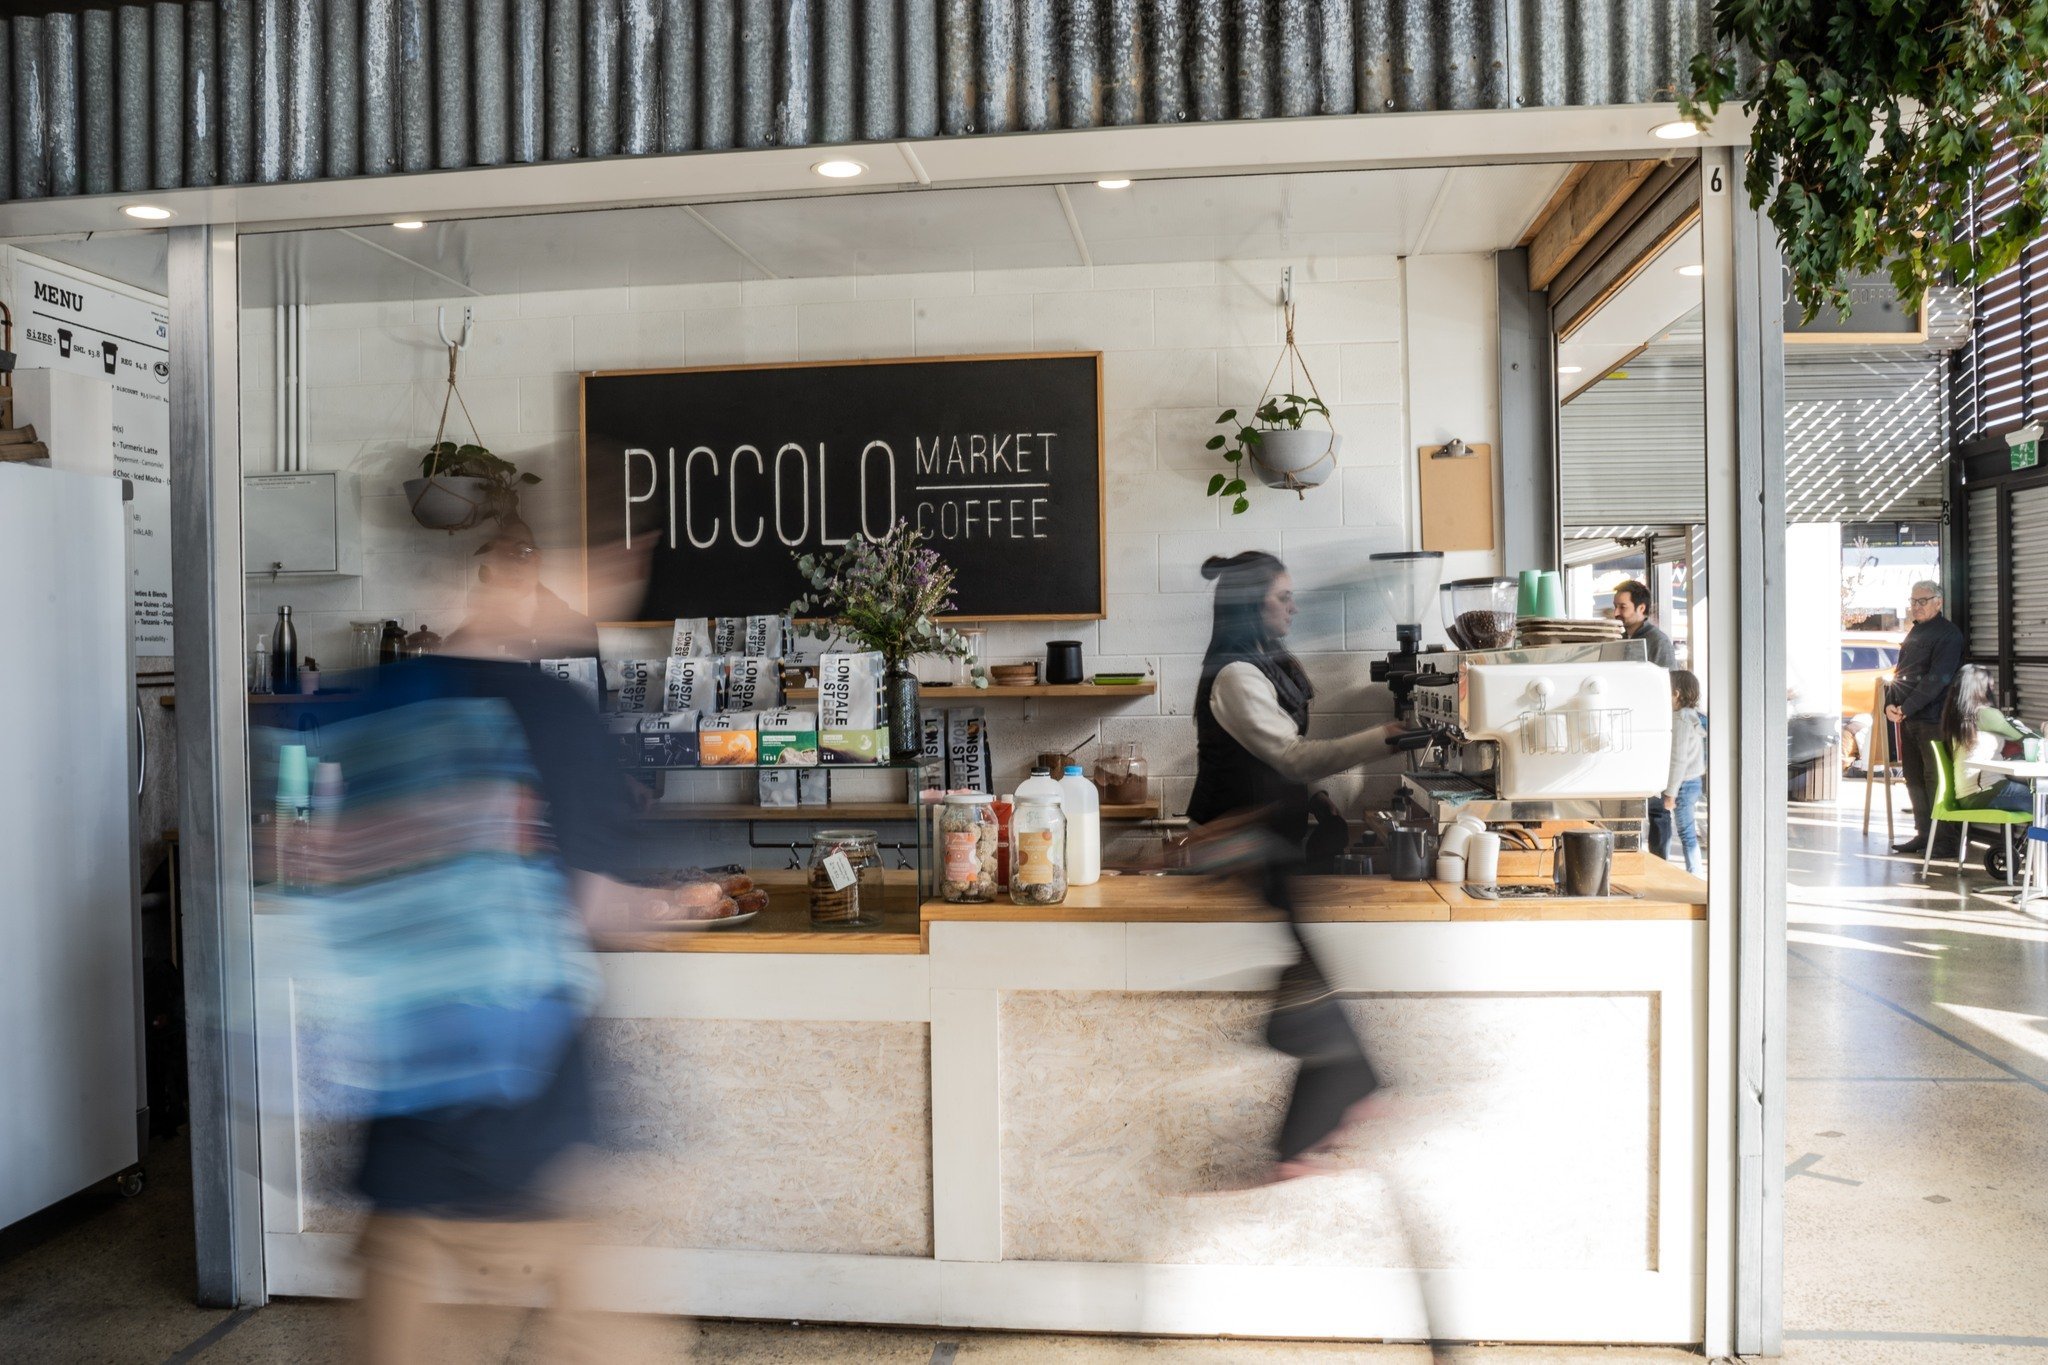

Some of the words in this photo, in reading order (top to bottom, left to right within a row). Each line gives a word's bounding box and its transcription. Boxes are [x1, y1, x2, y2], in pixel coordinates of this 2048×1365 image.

[1710, 167, 1722, 193] 6
[34, 281, 83, 312] MENU
[1851, 288, 1899, 305] COFFE
[73, 345, 86, 354] SML
[88, 349, 101, 358] $3.8
[121, 357, 133, 366] REG
[119, 440, 143, 453] Turmeric
[143, 446, 158, 456] Latte
[915, 432, 1058, 475] MARKET
[116, 469, 130, 479] Choc
[145, 475, 162, 484] Mocha
[624, 440, 896, 549] PICCOLO
[917, 499, 1048, 541] COFFEE
[724, 619, 735, 656] LONSDA
[632, 663, 648, 713] LONSDA
[741, 660, 758, 711] LONSDA
[823, 658, 836, 727] ROASTERS
[836, 658, 850, 726] LONSDALE
[924, 718, 942, 790] LONSALE
[966, 718, 981, 790] LONSDALE
